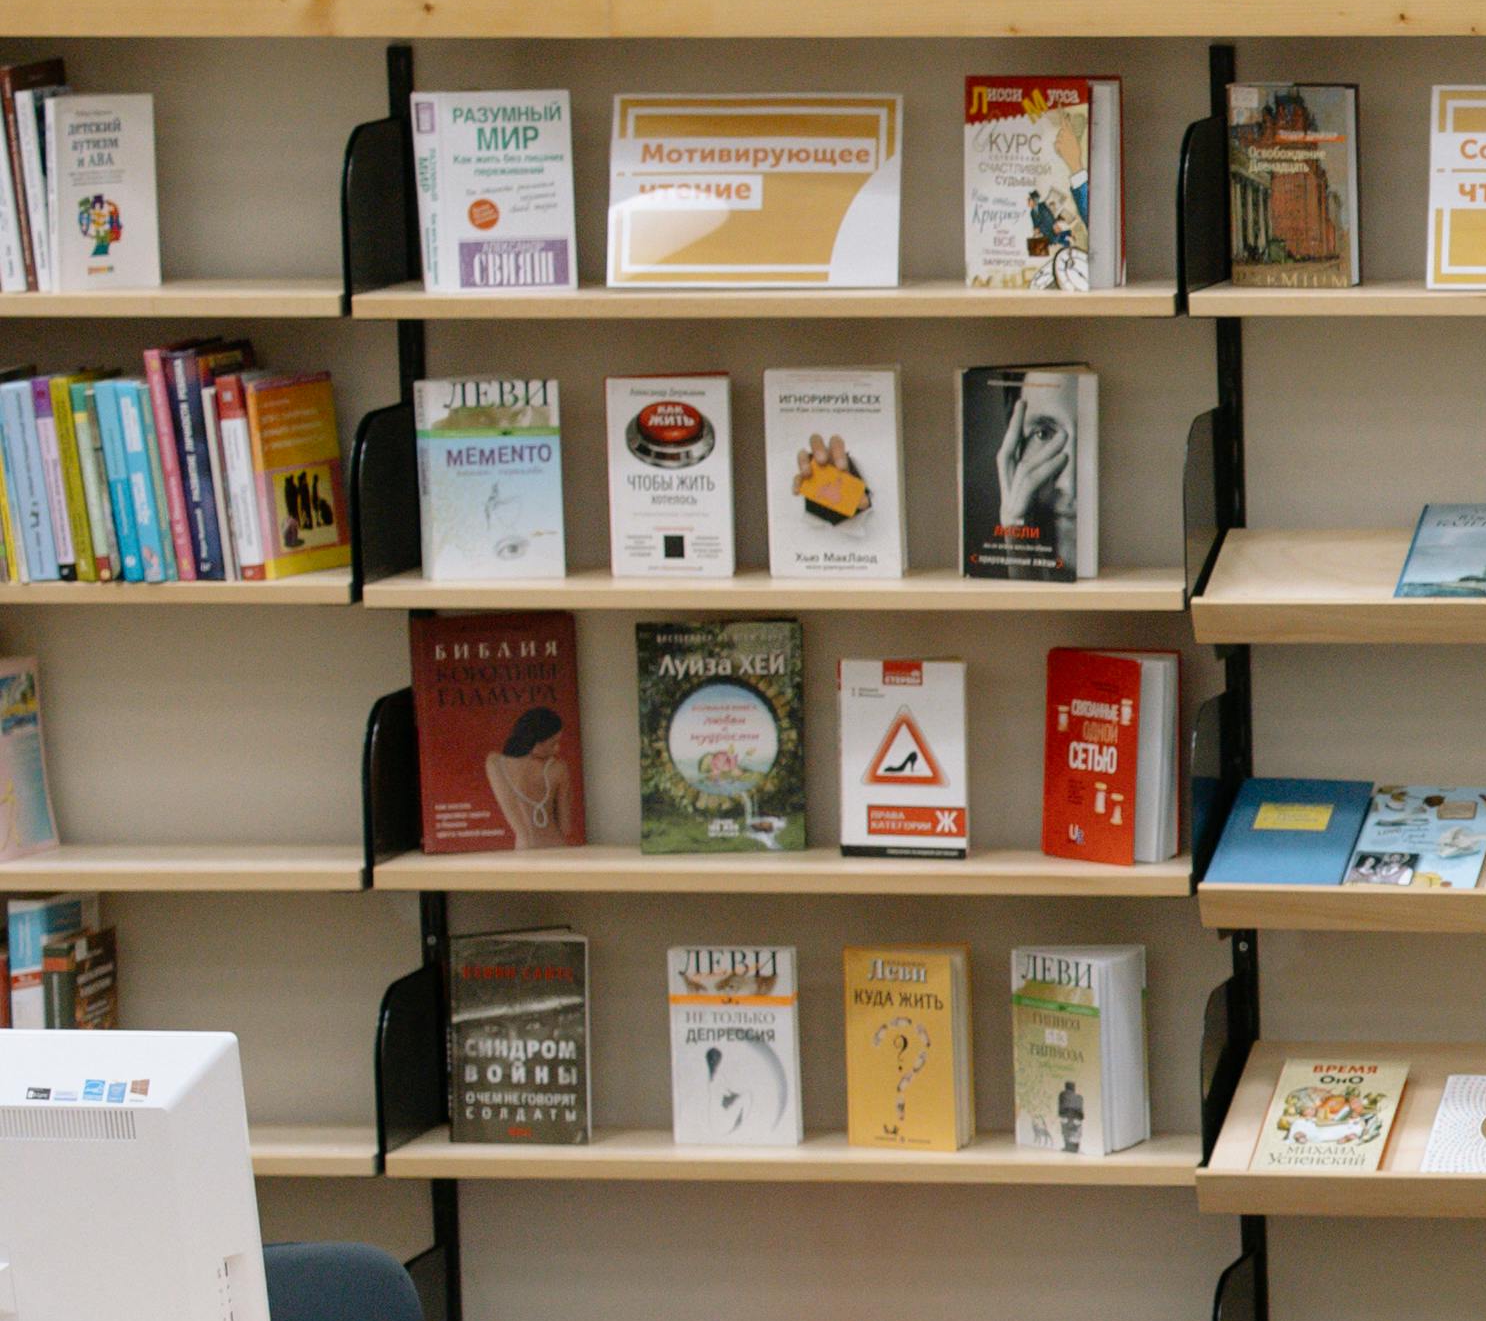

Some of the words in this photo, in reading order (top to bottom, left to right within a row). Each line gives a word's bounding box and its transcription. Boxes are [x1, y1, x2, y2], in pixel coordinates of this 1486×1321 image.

[453, 102, 561, 125] РАЗУМНЫЙ
[970, 86, 1022, 115] Лисси
[1022, 88, 1081, 126] Мусса
[477, 127, 539, 151] МИР
[987, 132, 1042, 156] КУРС
[640, 143, 870, 167] Мотивирующее
[1247, 147, 1326, 160] Освобождение
[639, 181, 750, 200] чтение
[473, 252, 553, 286] СВИЯШ
[444, 381, 548, 408] ЛЕВИ
[779, 392, 850, 405] ИГНОРИРУЙ
[852, 394, 881, 404] ВСЕХ
[649, 415, 694, 427] ЖИТЬ
[446, 444, 552, 467] MEMENTO
[627, 475, 673, 491] ЧТОБЫ
[676, 475, 715, 492] ЖИТЬ
[434, 641, 558, 661] БИБЛИЯ
[658, 653, 731, 677] Луиза
[739, 653, 785, 675] ХЕЙ
[437, 685, 558, 708] ГЛАМУРА
[1068, 742, 1118, 773] СЕТЬЮ
[679, 950, 777, 975] ЛЕВИ
[1021, 954, 1093, 989] ЛЕВИ
[854, 989, 894, 1005] КУДА
[899, 993, 943, 1011] ЖИТЬ
[686, 1028, 775, 1044] ДЕПРЕССИЯ
[465, 1040, 576, 1060] СИНДРОМ
[465, 1065, 576, 1085] ВОЙНЫ
[1312, 1064, 1378, 1075] ВРЕМЯ
[466, 1108, 576, 1121] СОЛДАТЫ
